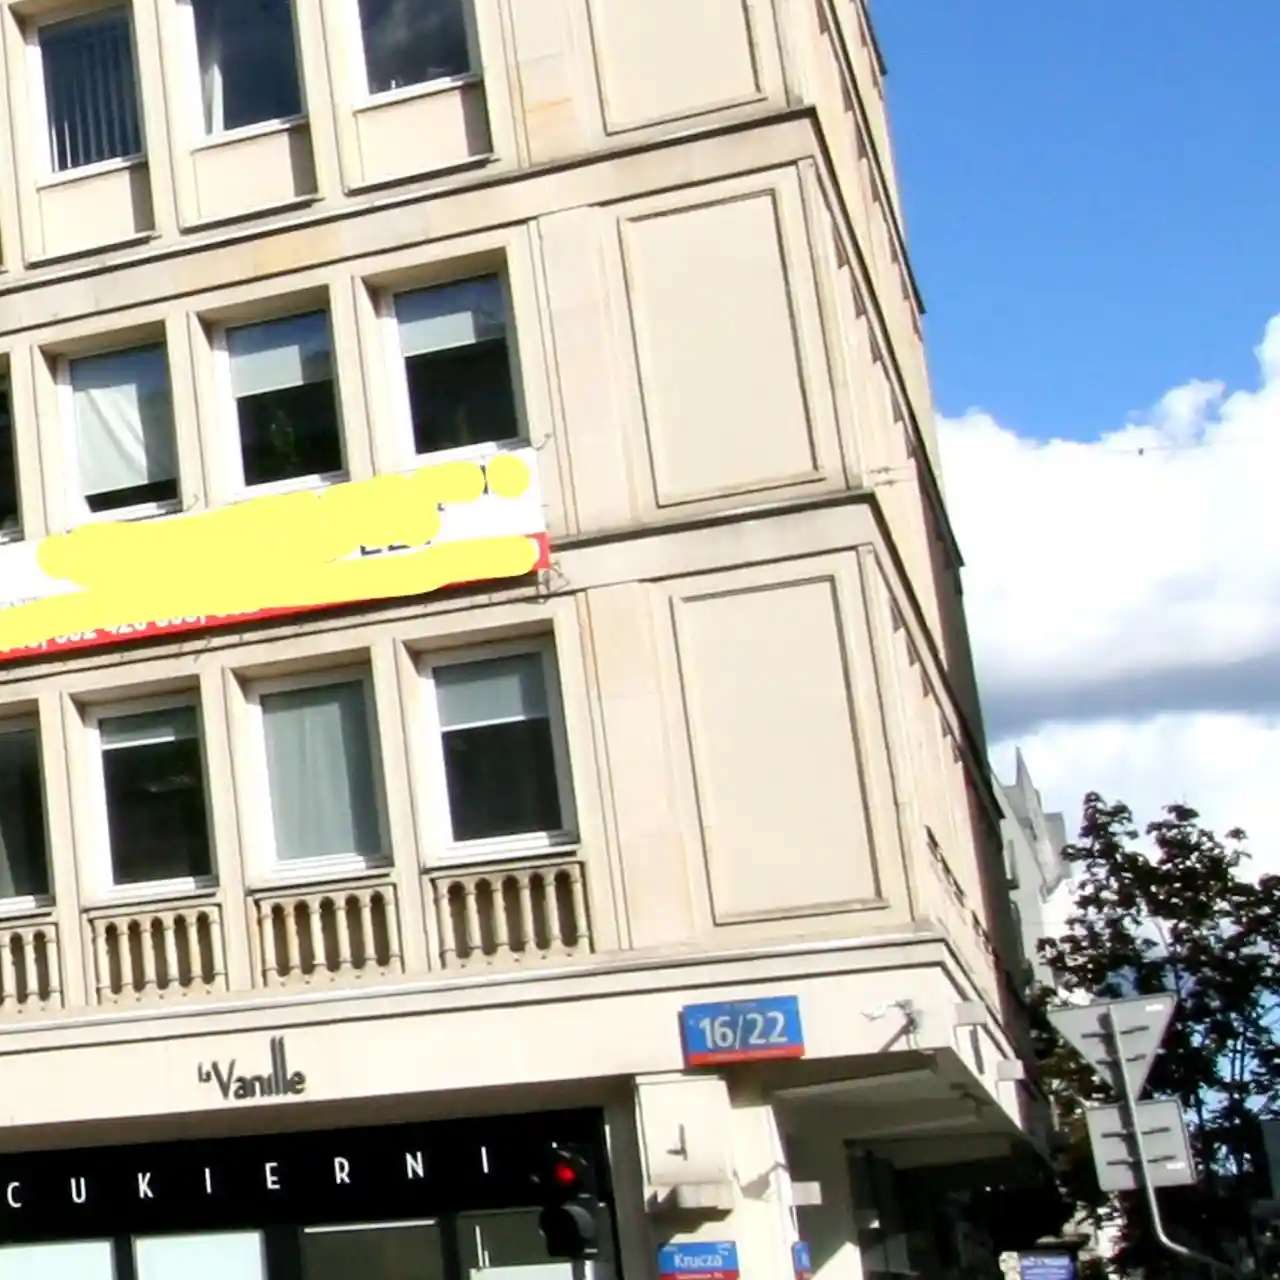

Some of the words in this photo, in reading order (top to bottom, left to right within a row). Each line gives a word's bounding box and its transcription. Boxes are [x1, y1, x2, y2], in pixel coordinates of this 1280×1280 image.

[698, 1010, 789, 1050] 16/22
[211, 1035, 307, 1100] Vanille
[6, 1145, 540, 1209] CUKIERNI
[673, 1252, 723, 1269] Krucza
